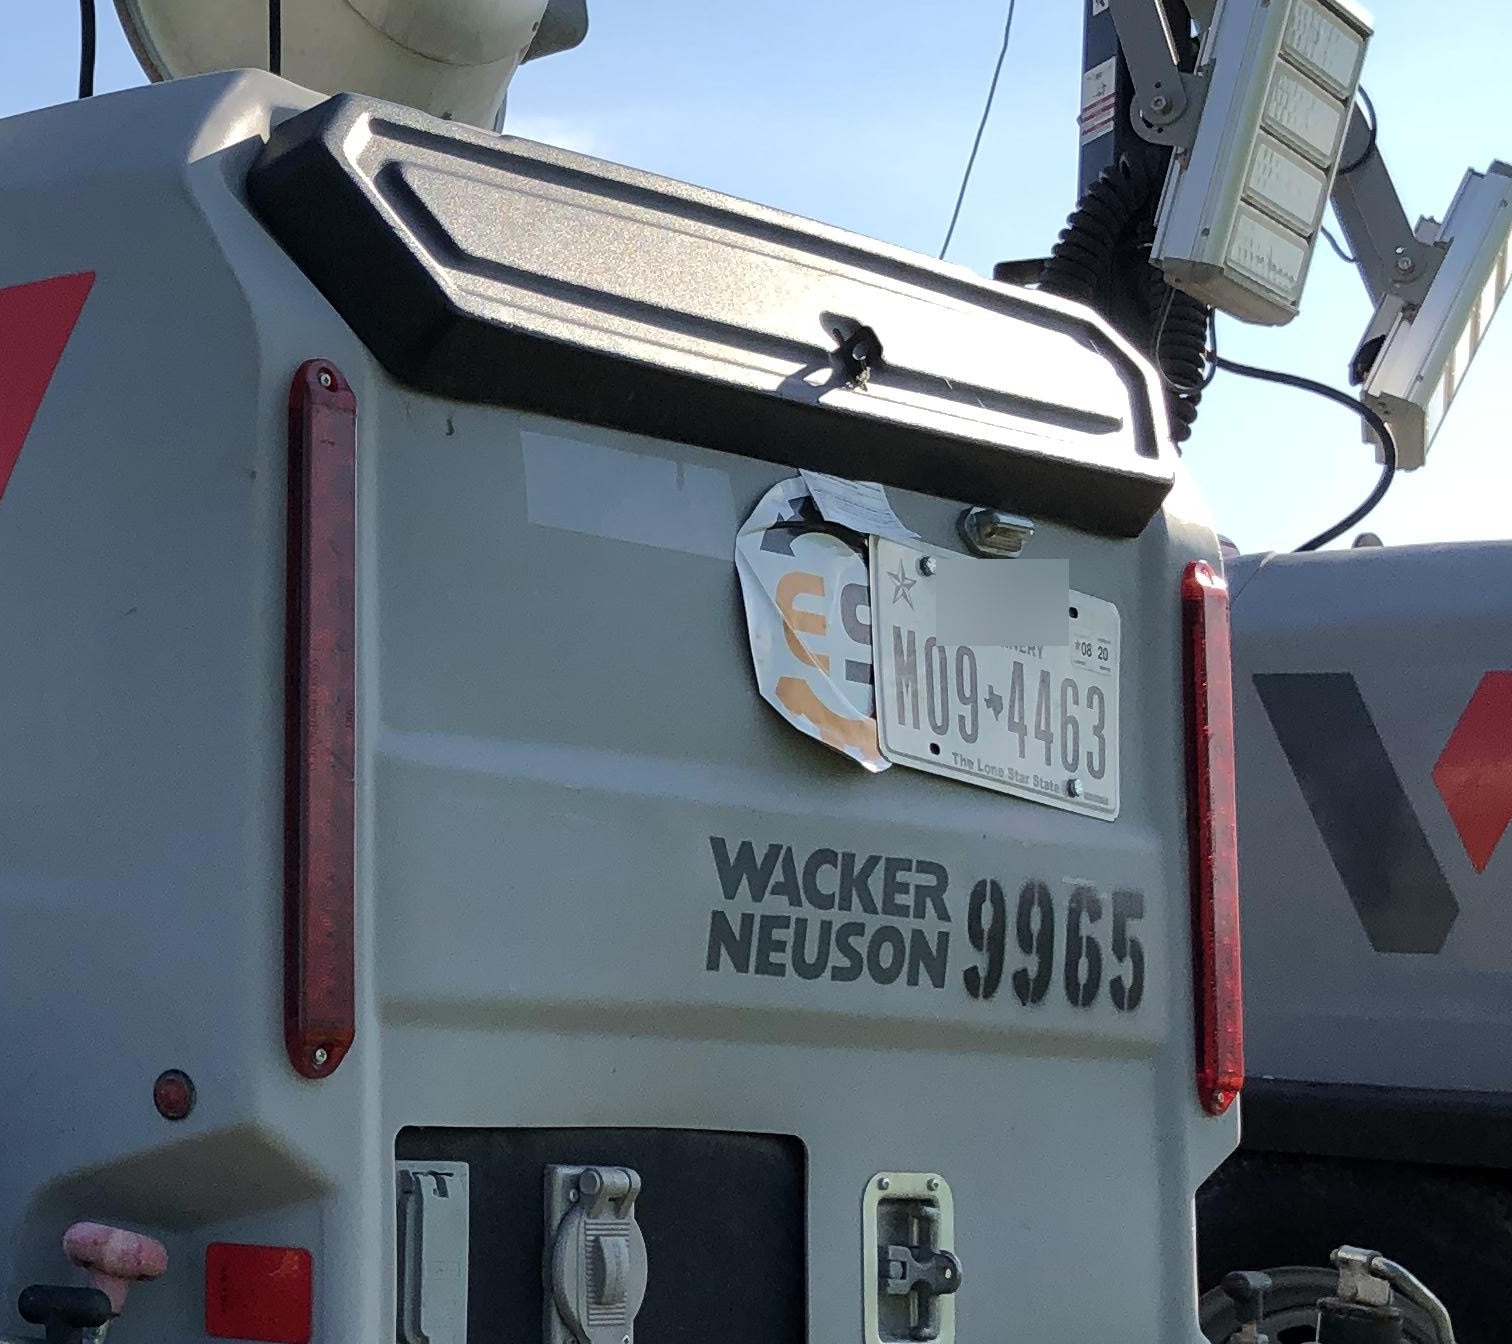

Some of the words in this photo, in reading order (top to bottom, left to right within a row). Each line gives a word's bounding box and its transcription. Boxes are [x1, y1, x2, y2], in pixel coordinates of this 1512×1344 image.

[1097, 645, 1109, 662] 20
[951, 751, 975, 770] The
[977, 758, 1005, 779] Lone
[1007, 766, 1031, 785] Star
[1032, 773, 1061, 793] State
[709, 835, 952, 923] WACKER
[705, 909, 950, 989] NEUSON
[962, 876, 1145, 1012] 9965
